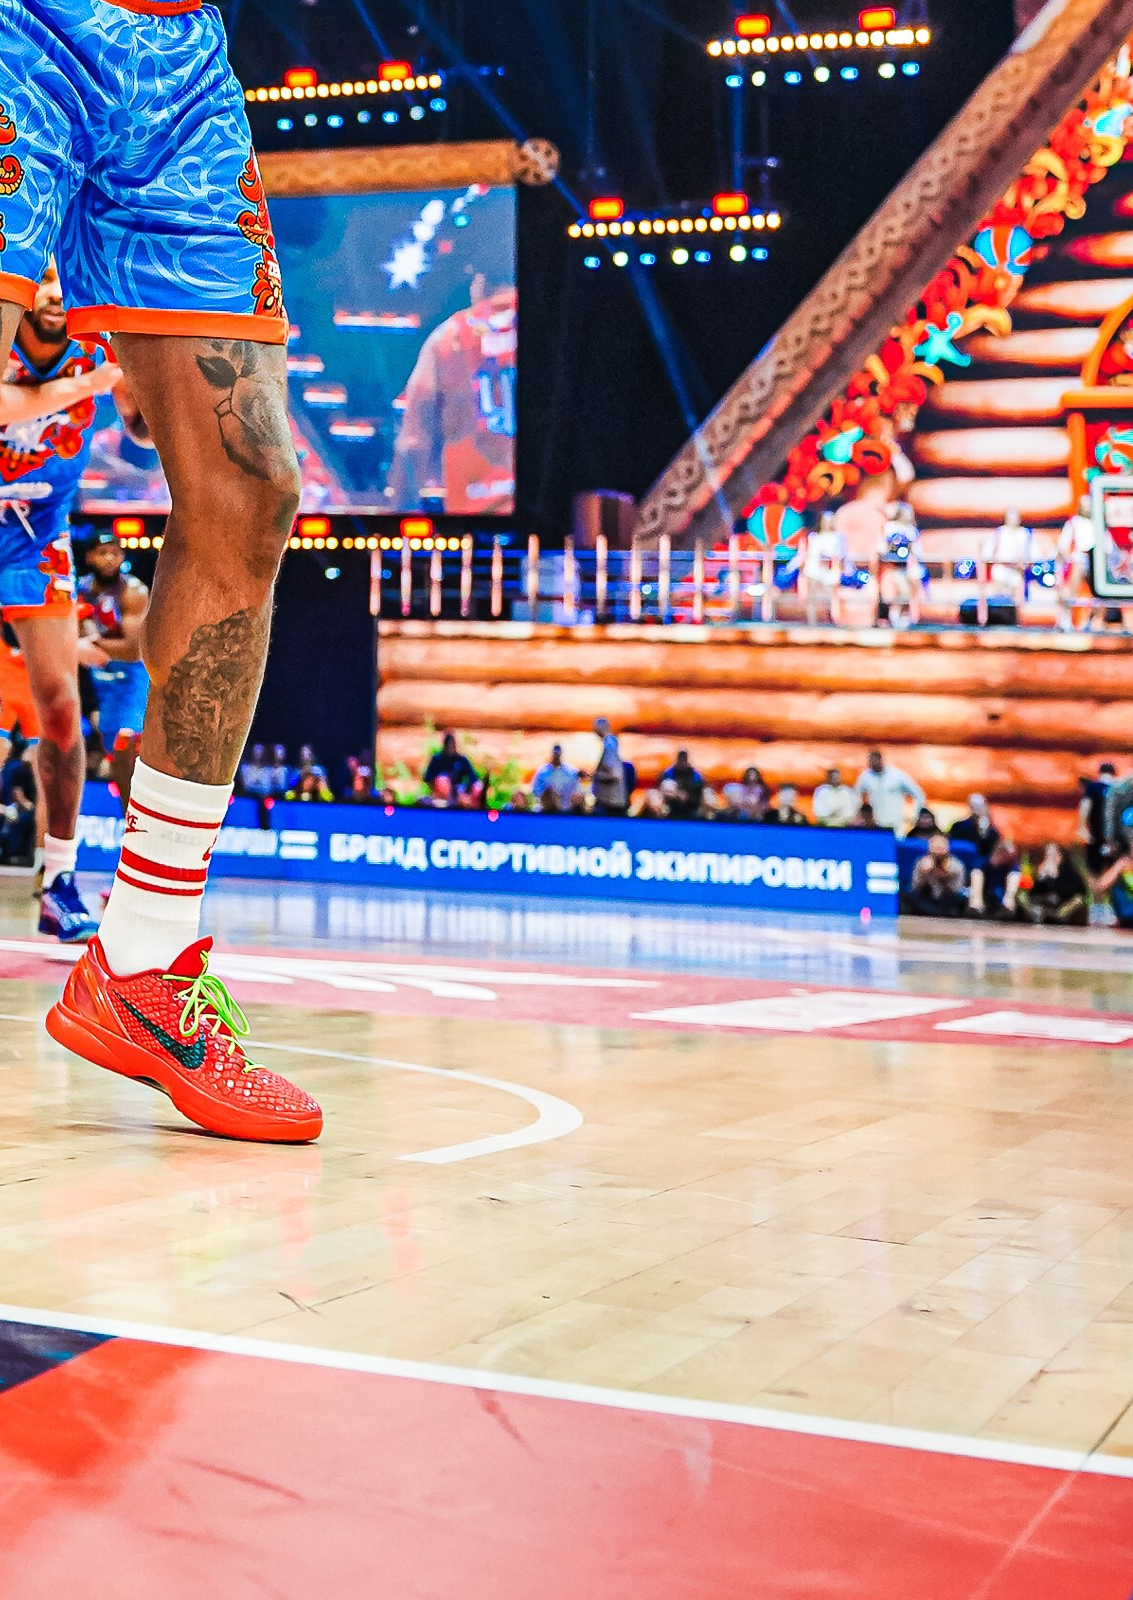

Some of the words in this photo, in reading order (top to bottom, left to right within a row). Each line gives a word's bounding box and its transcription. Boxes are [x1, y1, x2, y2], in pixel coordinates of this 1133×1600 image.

[330, 833, 427, 870] БРЕНД
[430, 839, 632, 879] СПОРТИВНОЙ
[635, 850, 852, 891] ЭКИПИРОВКИ
